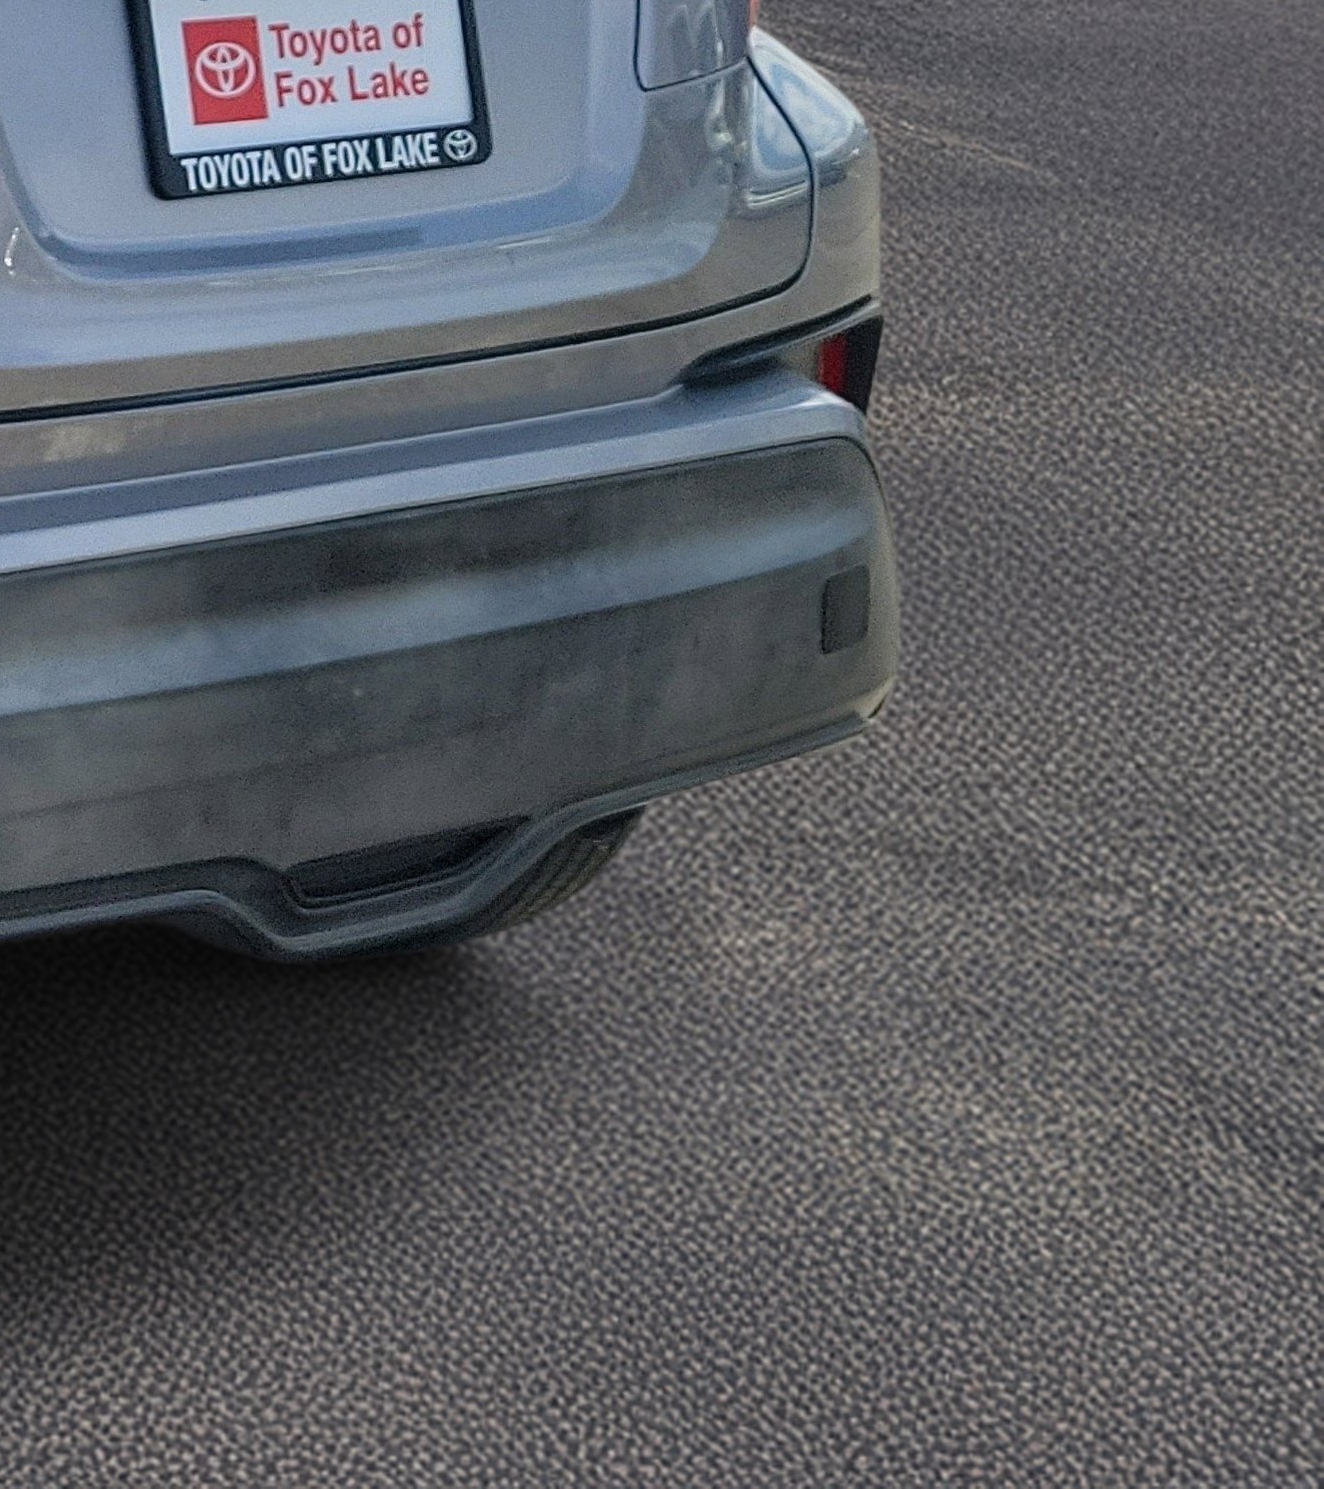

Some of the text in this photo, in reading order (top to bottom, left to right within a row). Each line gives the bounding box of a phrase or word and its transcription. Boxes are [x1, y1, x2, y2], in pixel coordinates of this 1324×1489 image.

[268, 13, 424, 66] Toyota of
[274, 62, 431, 108] Fox Lake
[181, 131, 441, 192] TOYOTA OF FOX LAKE
